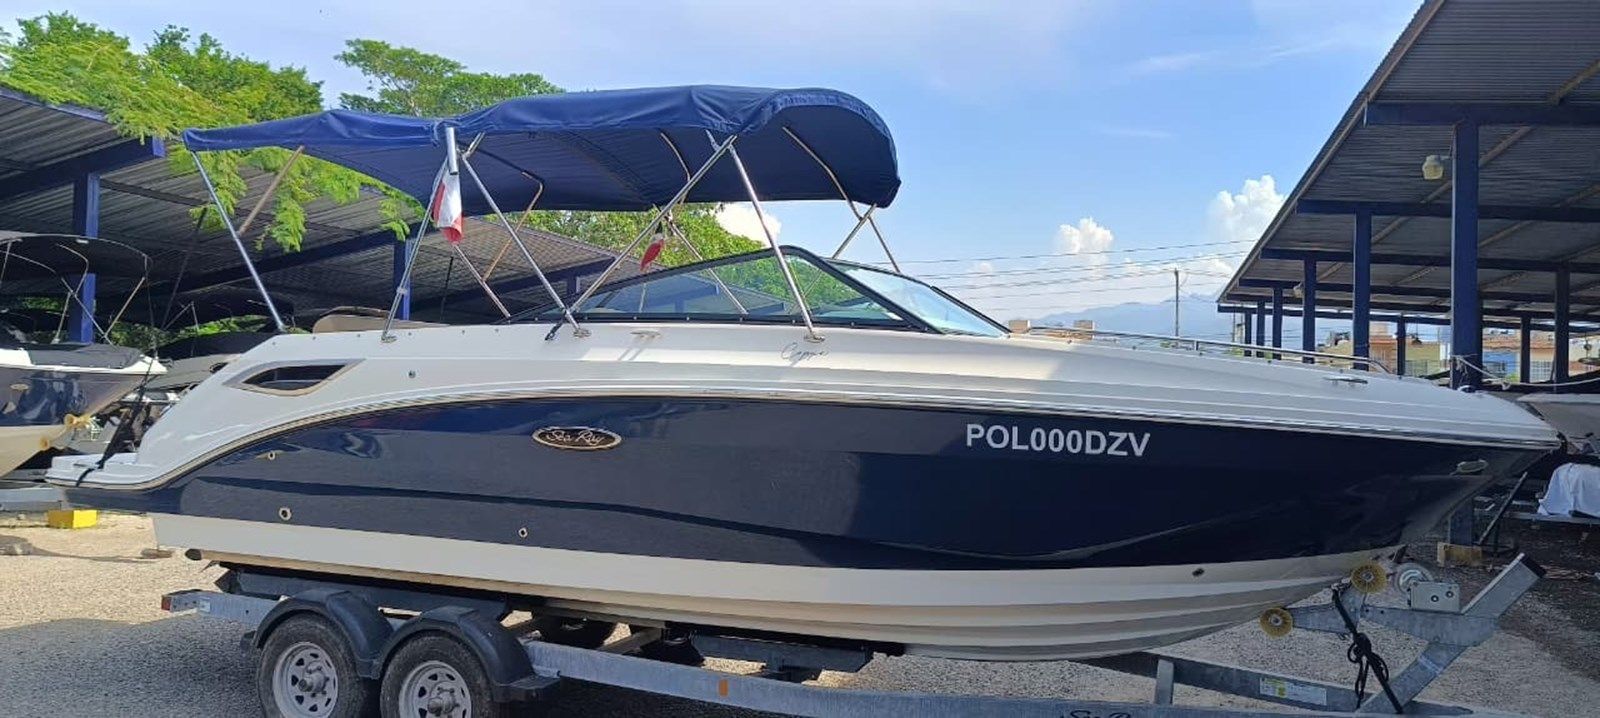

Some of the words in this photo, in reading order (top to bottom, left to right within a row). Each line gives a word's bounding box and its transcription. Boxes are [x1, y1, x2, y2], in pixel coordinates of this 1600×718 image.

[546, 430, 573, 442] Sea
[575, 429, 606, 446] Ray
[966, 423, 1150, 456] POL000DZV
